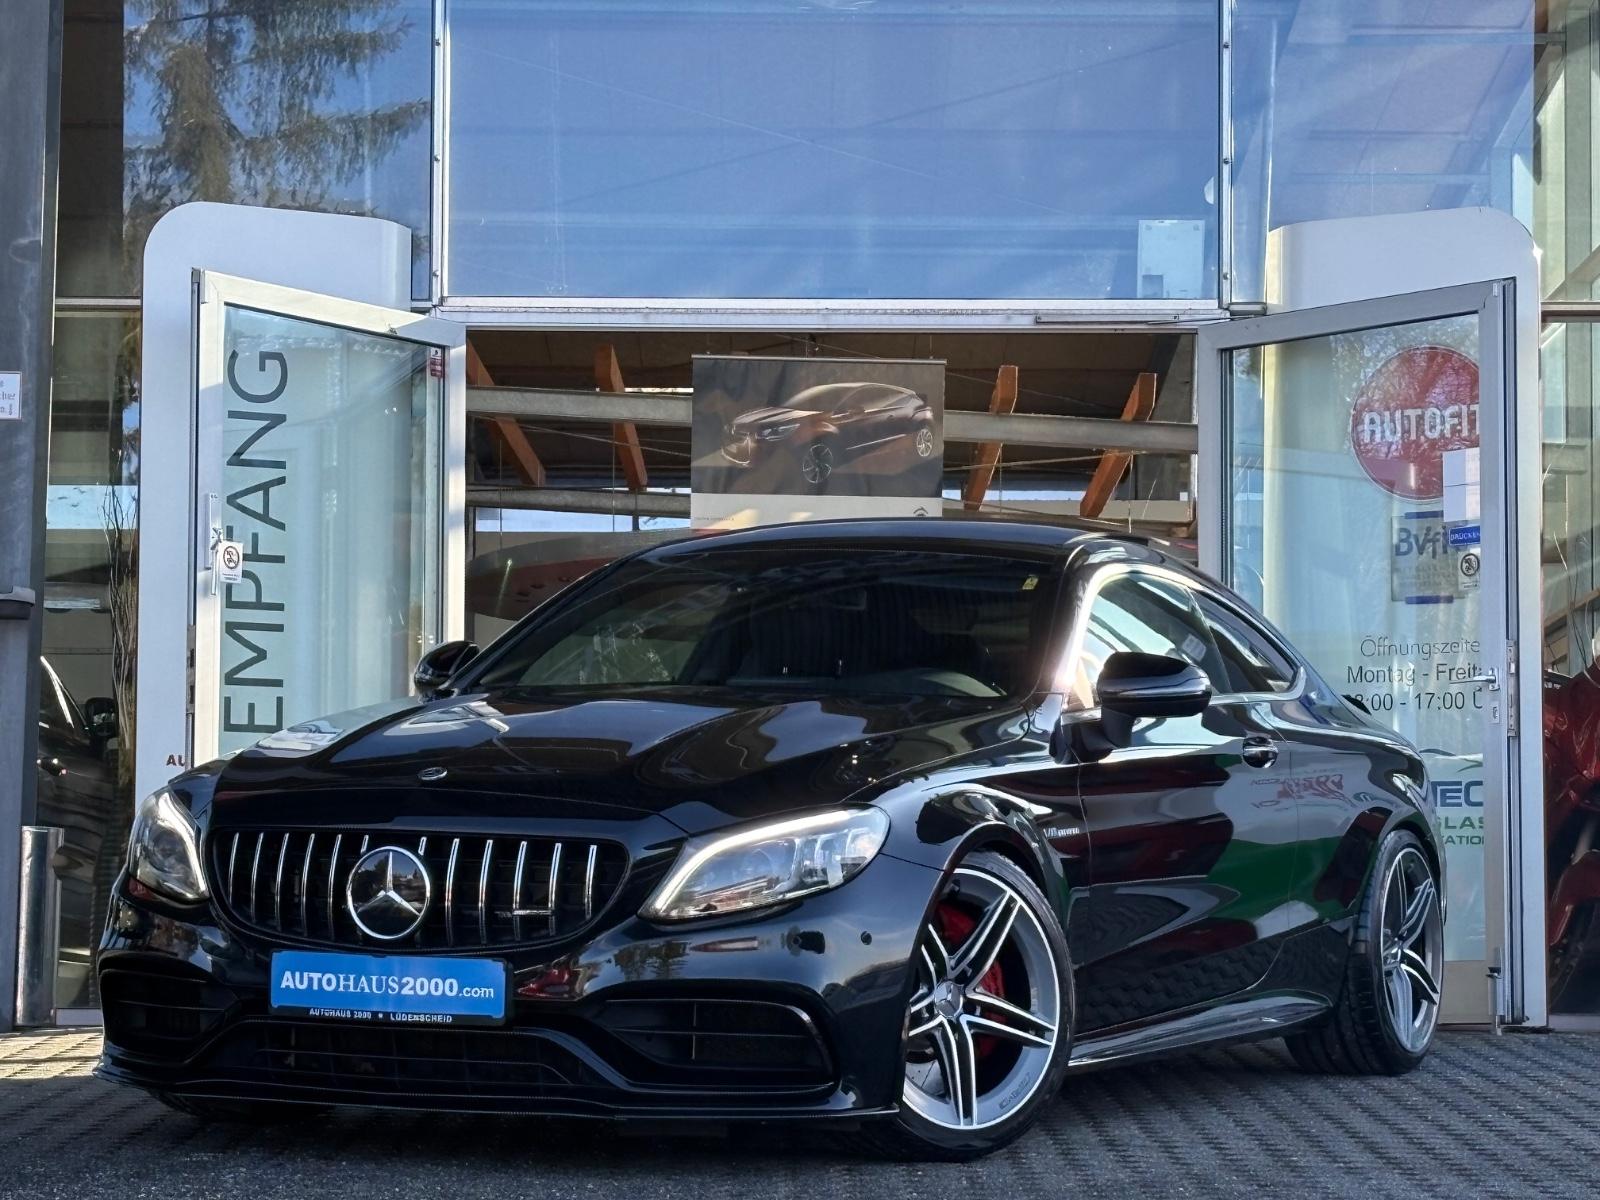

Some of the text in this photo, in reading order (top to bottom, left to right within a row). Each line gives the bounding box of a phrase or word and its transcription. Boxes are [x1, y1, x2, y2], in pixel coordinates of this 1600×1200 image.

[223, 349, 288, 734] EMPFANG
[1347, 664, 1416, 687] Montag
[1414, 691, 1465, 711] 17:00
[280, 970, 494, 999] AUTOHAUS2000.com
[309, 1007, 351, 1018] AUTOHAUS
